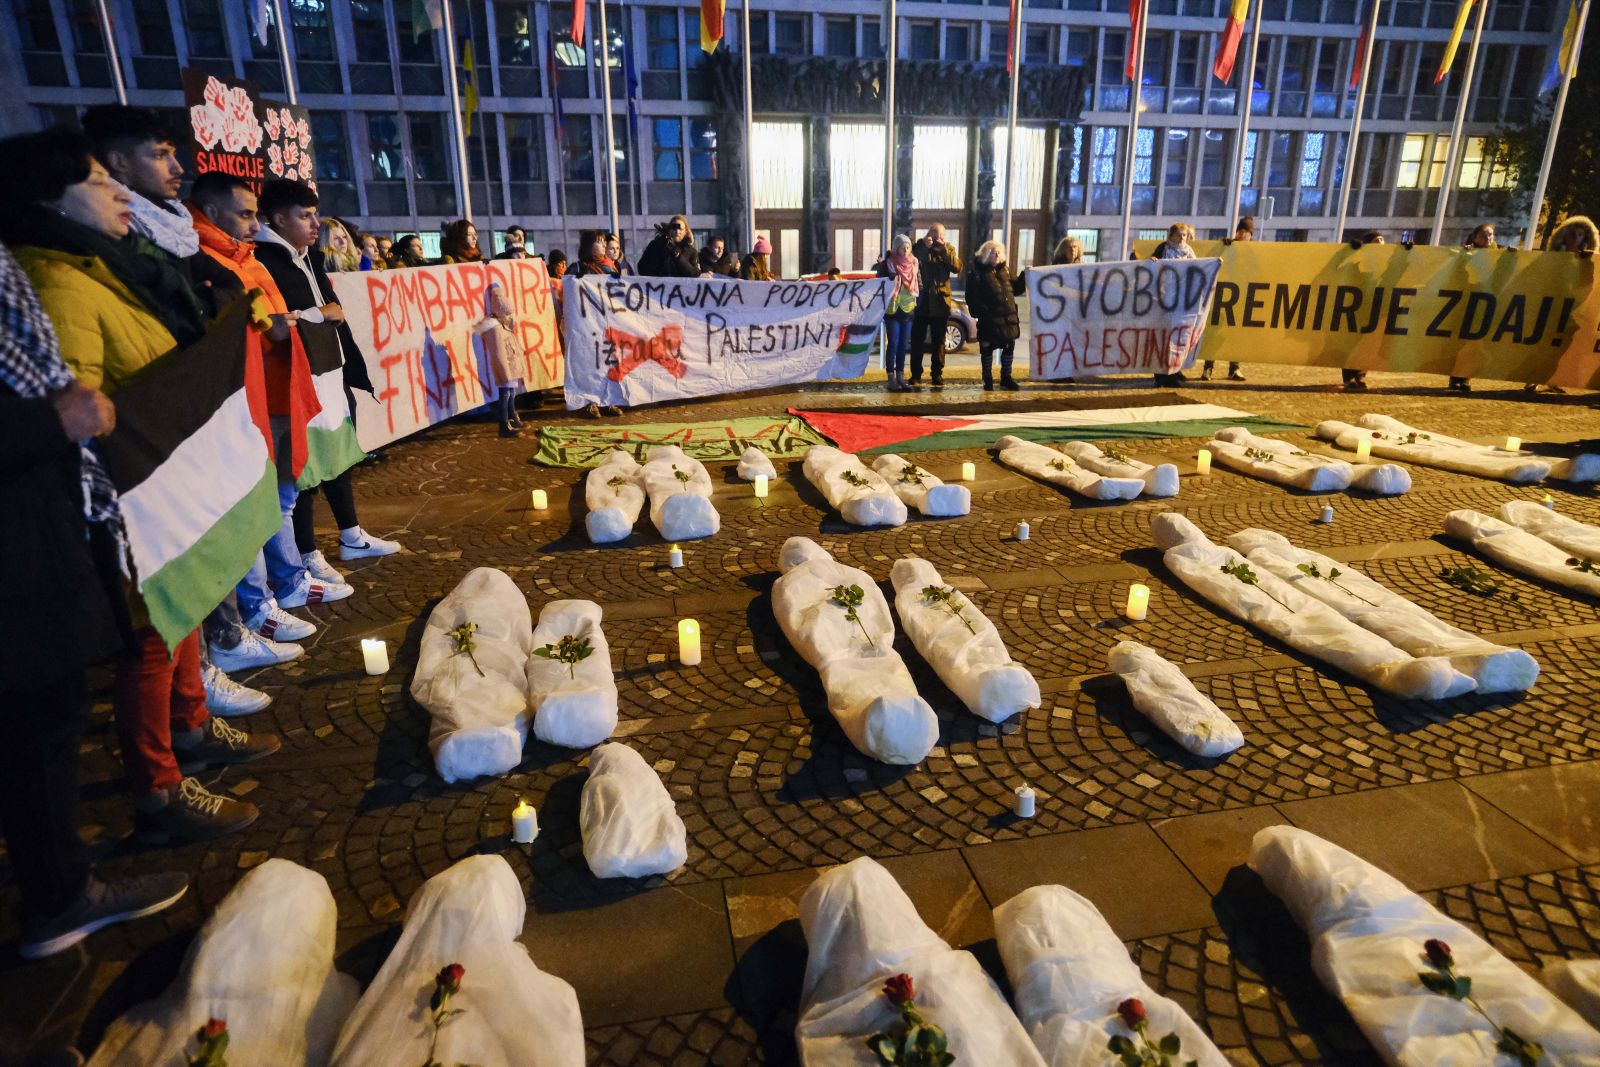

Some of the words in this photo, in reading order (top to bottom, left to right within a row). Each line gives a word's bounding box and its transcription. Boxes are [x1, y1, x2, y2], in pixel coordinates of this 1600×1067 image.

[196, 152, 264, 178] SANKCIJE
[579, 282, 744, 318] NEOMAJNA
[764, 280, 887, 312] PODPORA
[1425, 289, 1576, 348] ZDAJ!
[704, 312, 833, 366] PALESTINI
[379, 317, 564, 434] FINANRA
